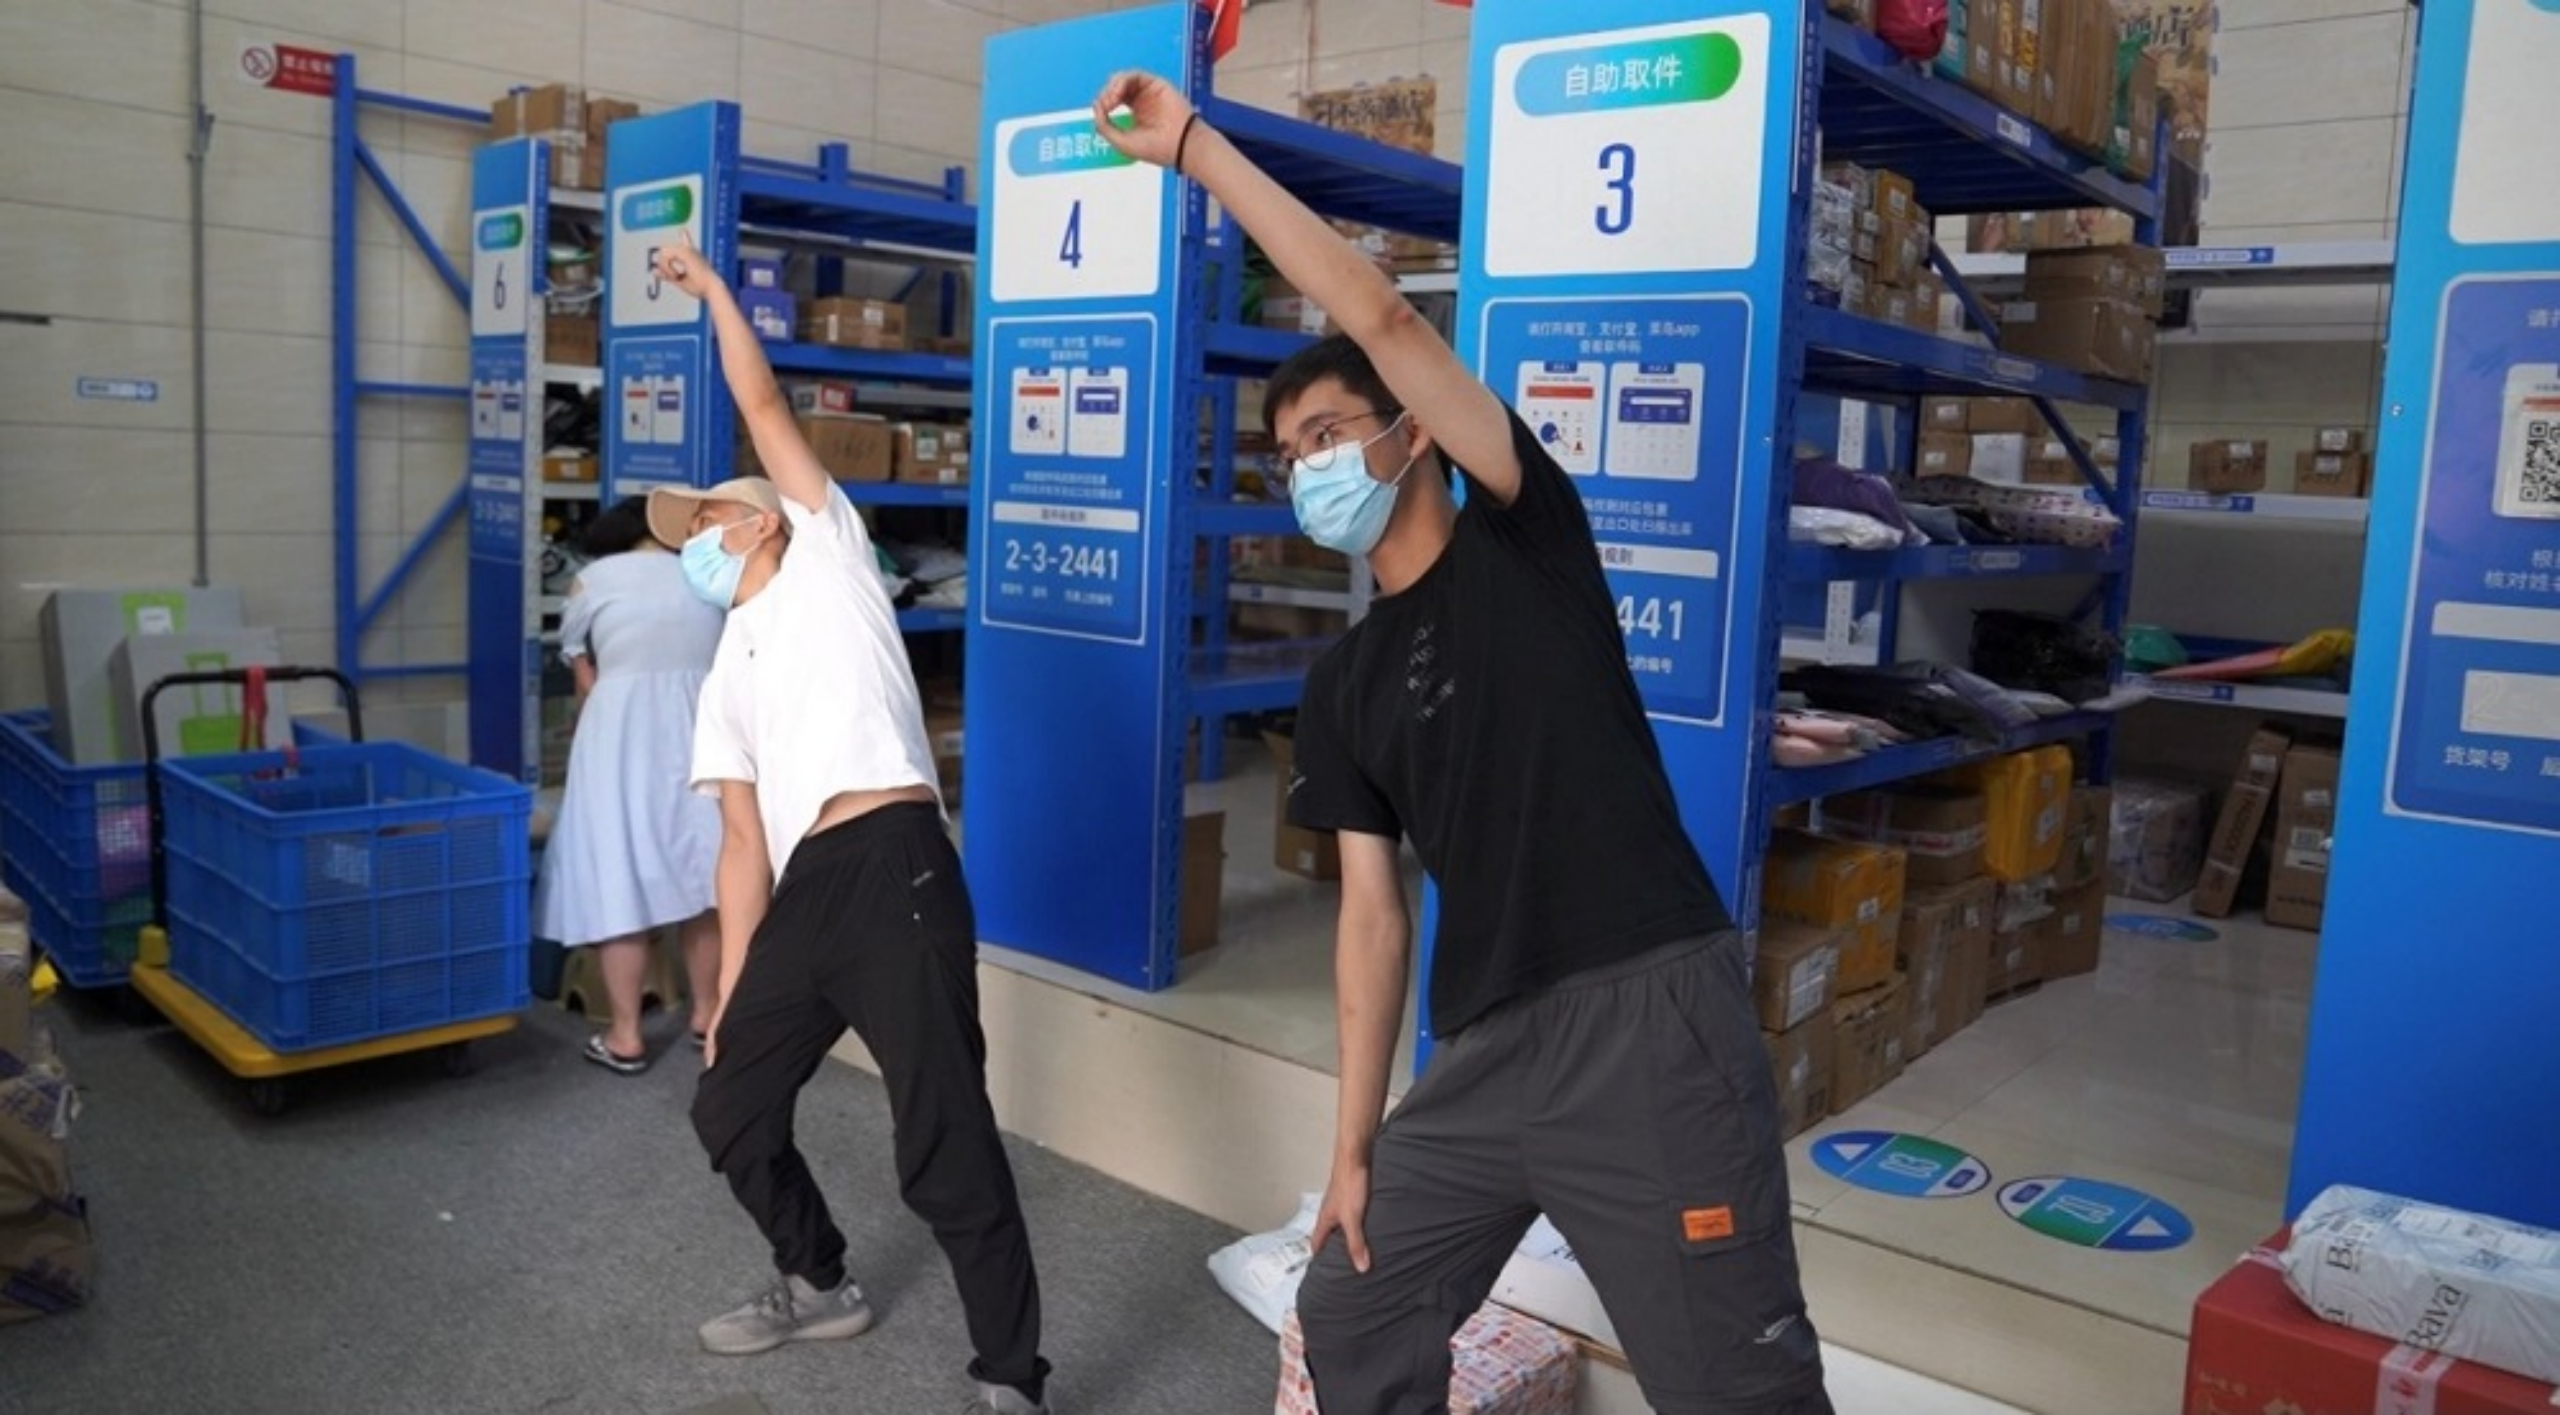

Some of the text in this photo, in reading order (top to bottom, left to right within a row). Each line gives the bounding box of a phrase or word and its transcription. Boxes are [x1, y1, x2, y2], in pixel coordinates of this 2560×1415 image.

[1565, 54, 1683, 98] 自助取件
[1595, 142, 1636, 236] 3
[1059, 199, 1083, 269] 4
[494, 261, 506, 311] 6
[1005, 538, 1120, 582] 2-3-2441
[1598, 547, 1634, 566] 规则
[1616, 595, 1684, 641] 441
[2443, 745, 2511, 772] 货架号
[2403, 1283, 2462, 1350] Bava
